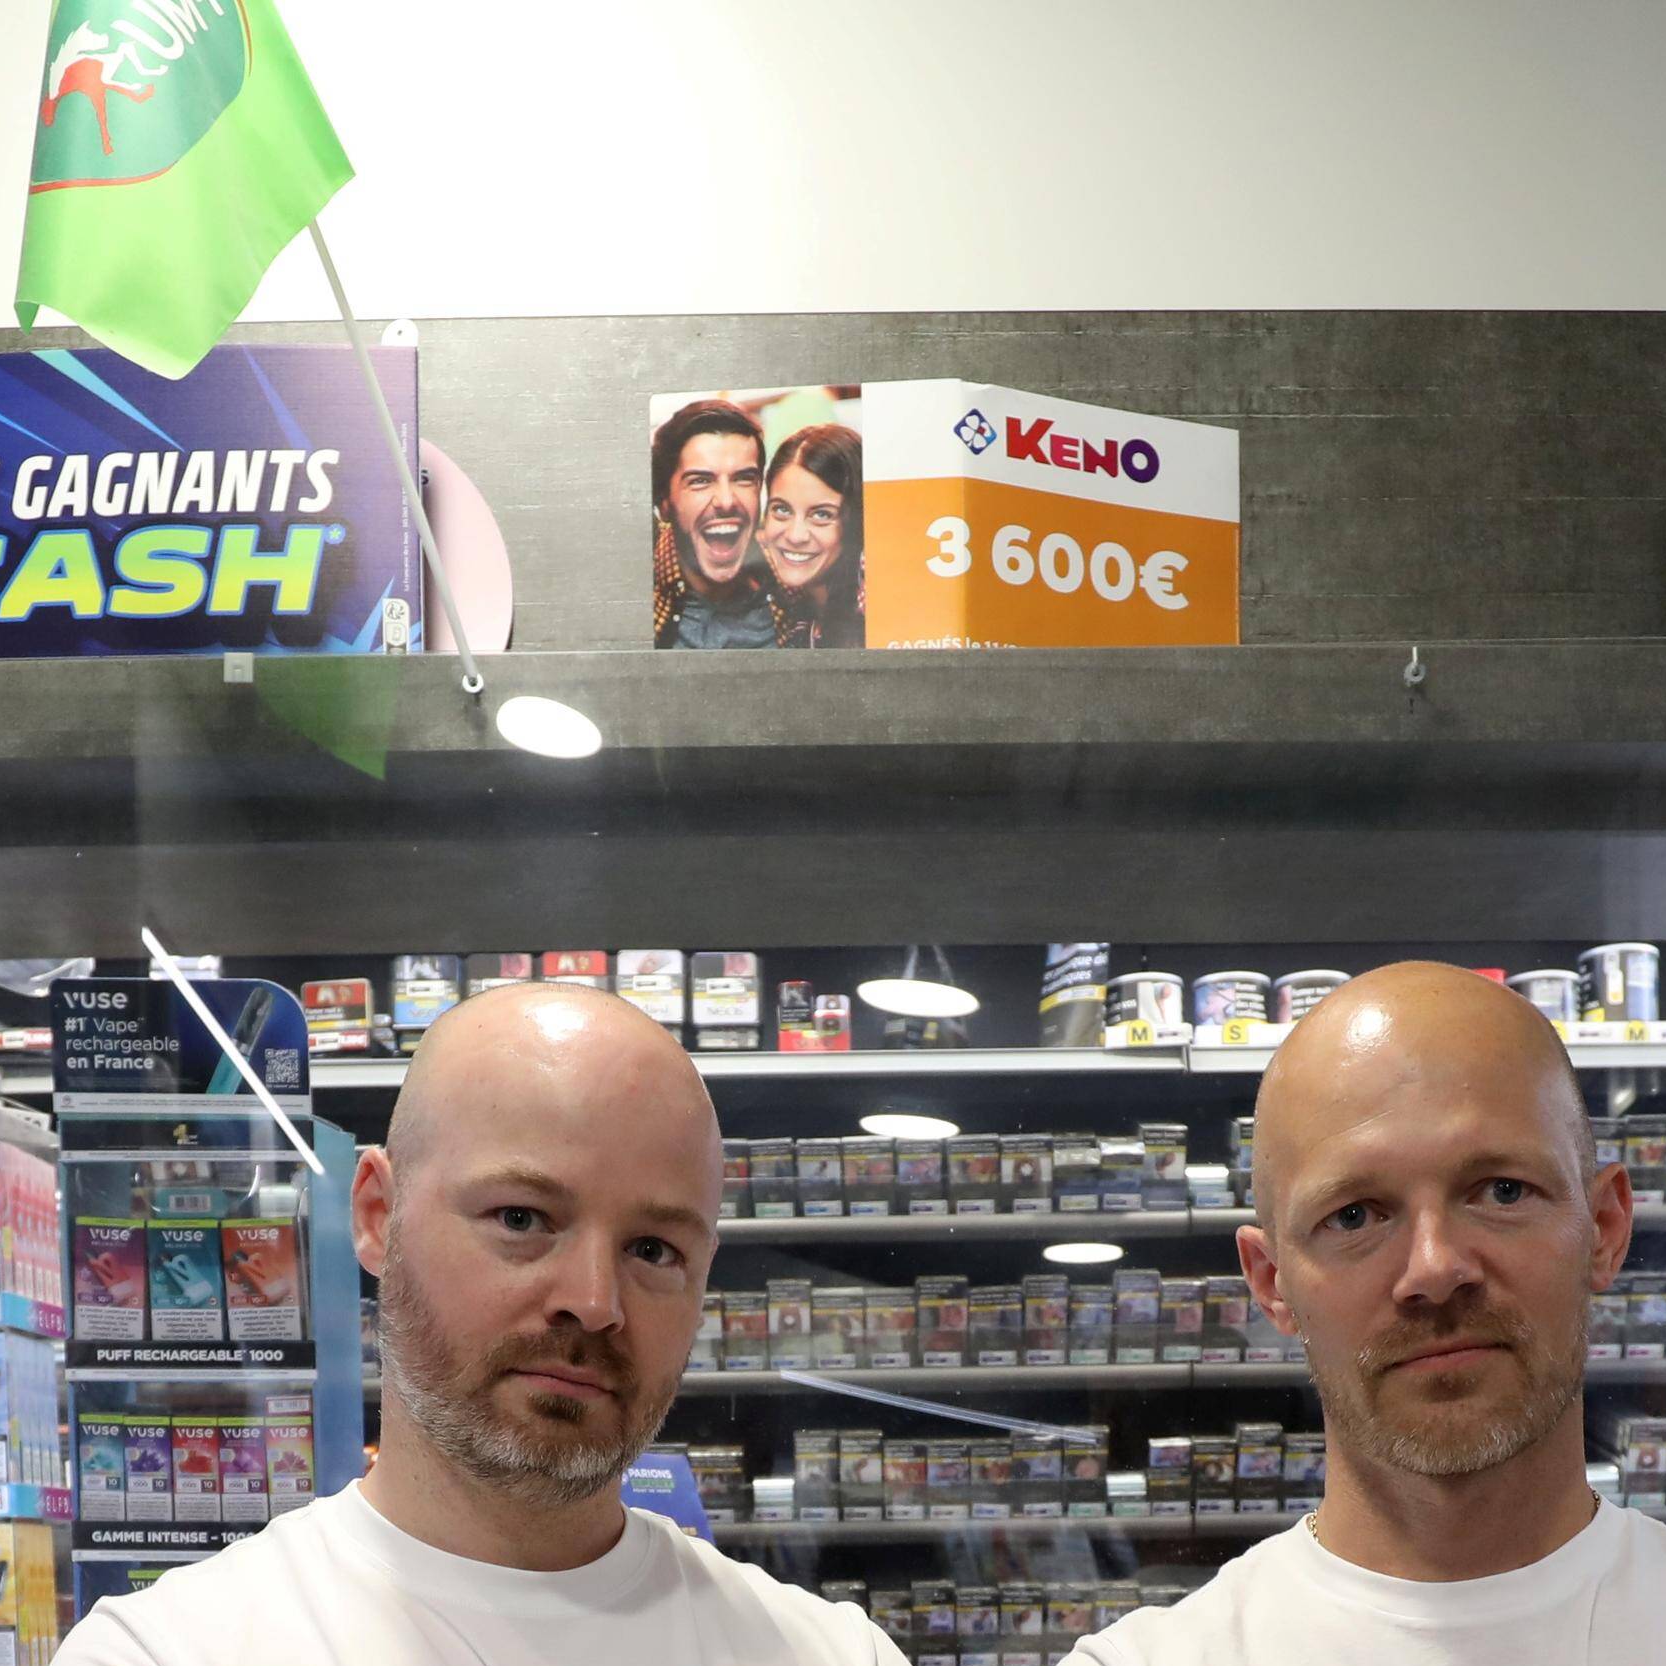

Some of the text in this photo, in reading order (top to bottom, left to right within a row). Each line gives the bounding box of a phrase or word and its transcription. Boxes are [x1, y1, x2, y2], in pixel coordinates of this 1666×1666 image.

[12, 449, 340, 520] GAGNANTS
[925, 516, 1190, 611] 3 600€
[64, 1017, 139, 1034] #1 Vape
[65, 1035, 180, 1053] rechargeable
[66, 1054, 154, 1070] en France
[97, 1349, 132, 1361] PUFF
[249, 1349, 284, 1361] 1000
[91, 1531, 144, 1543] GAMME
[147, 1531, 208, 1543] INTENSE
